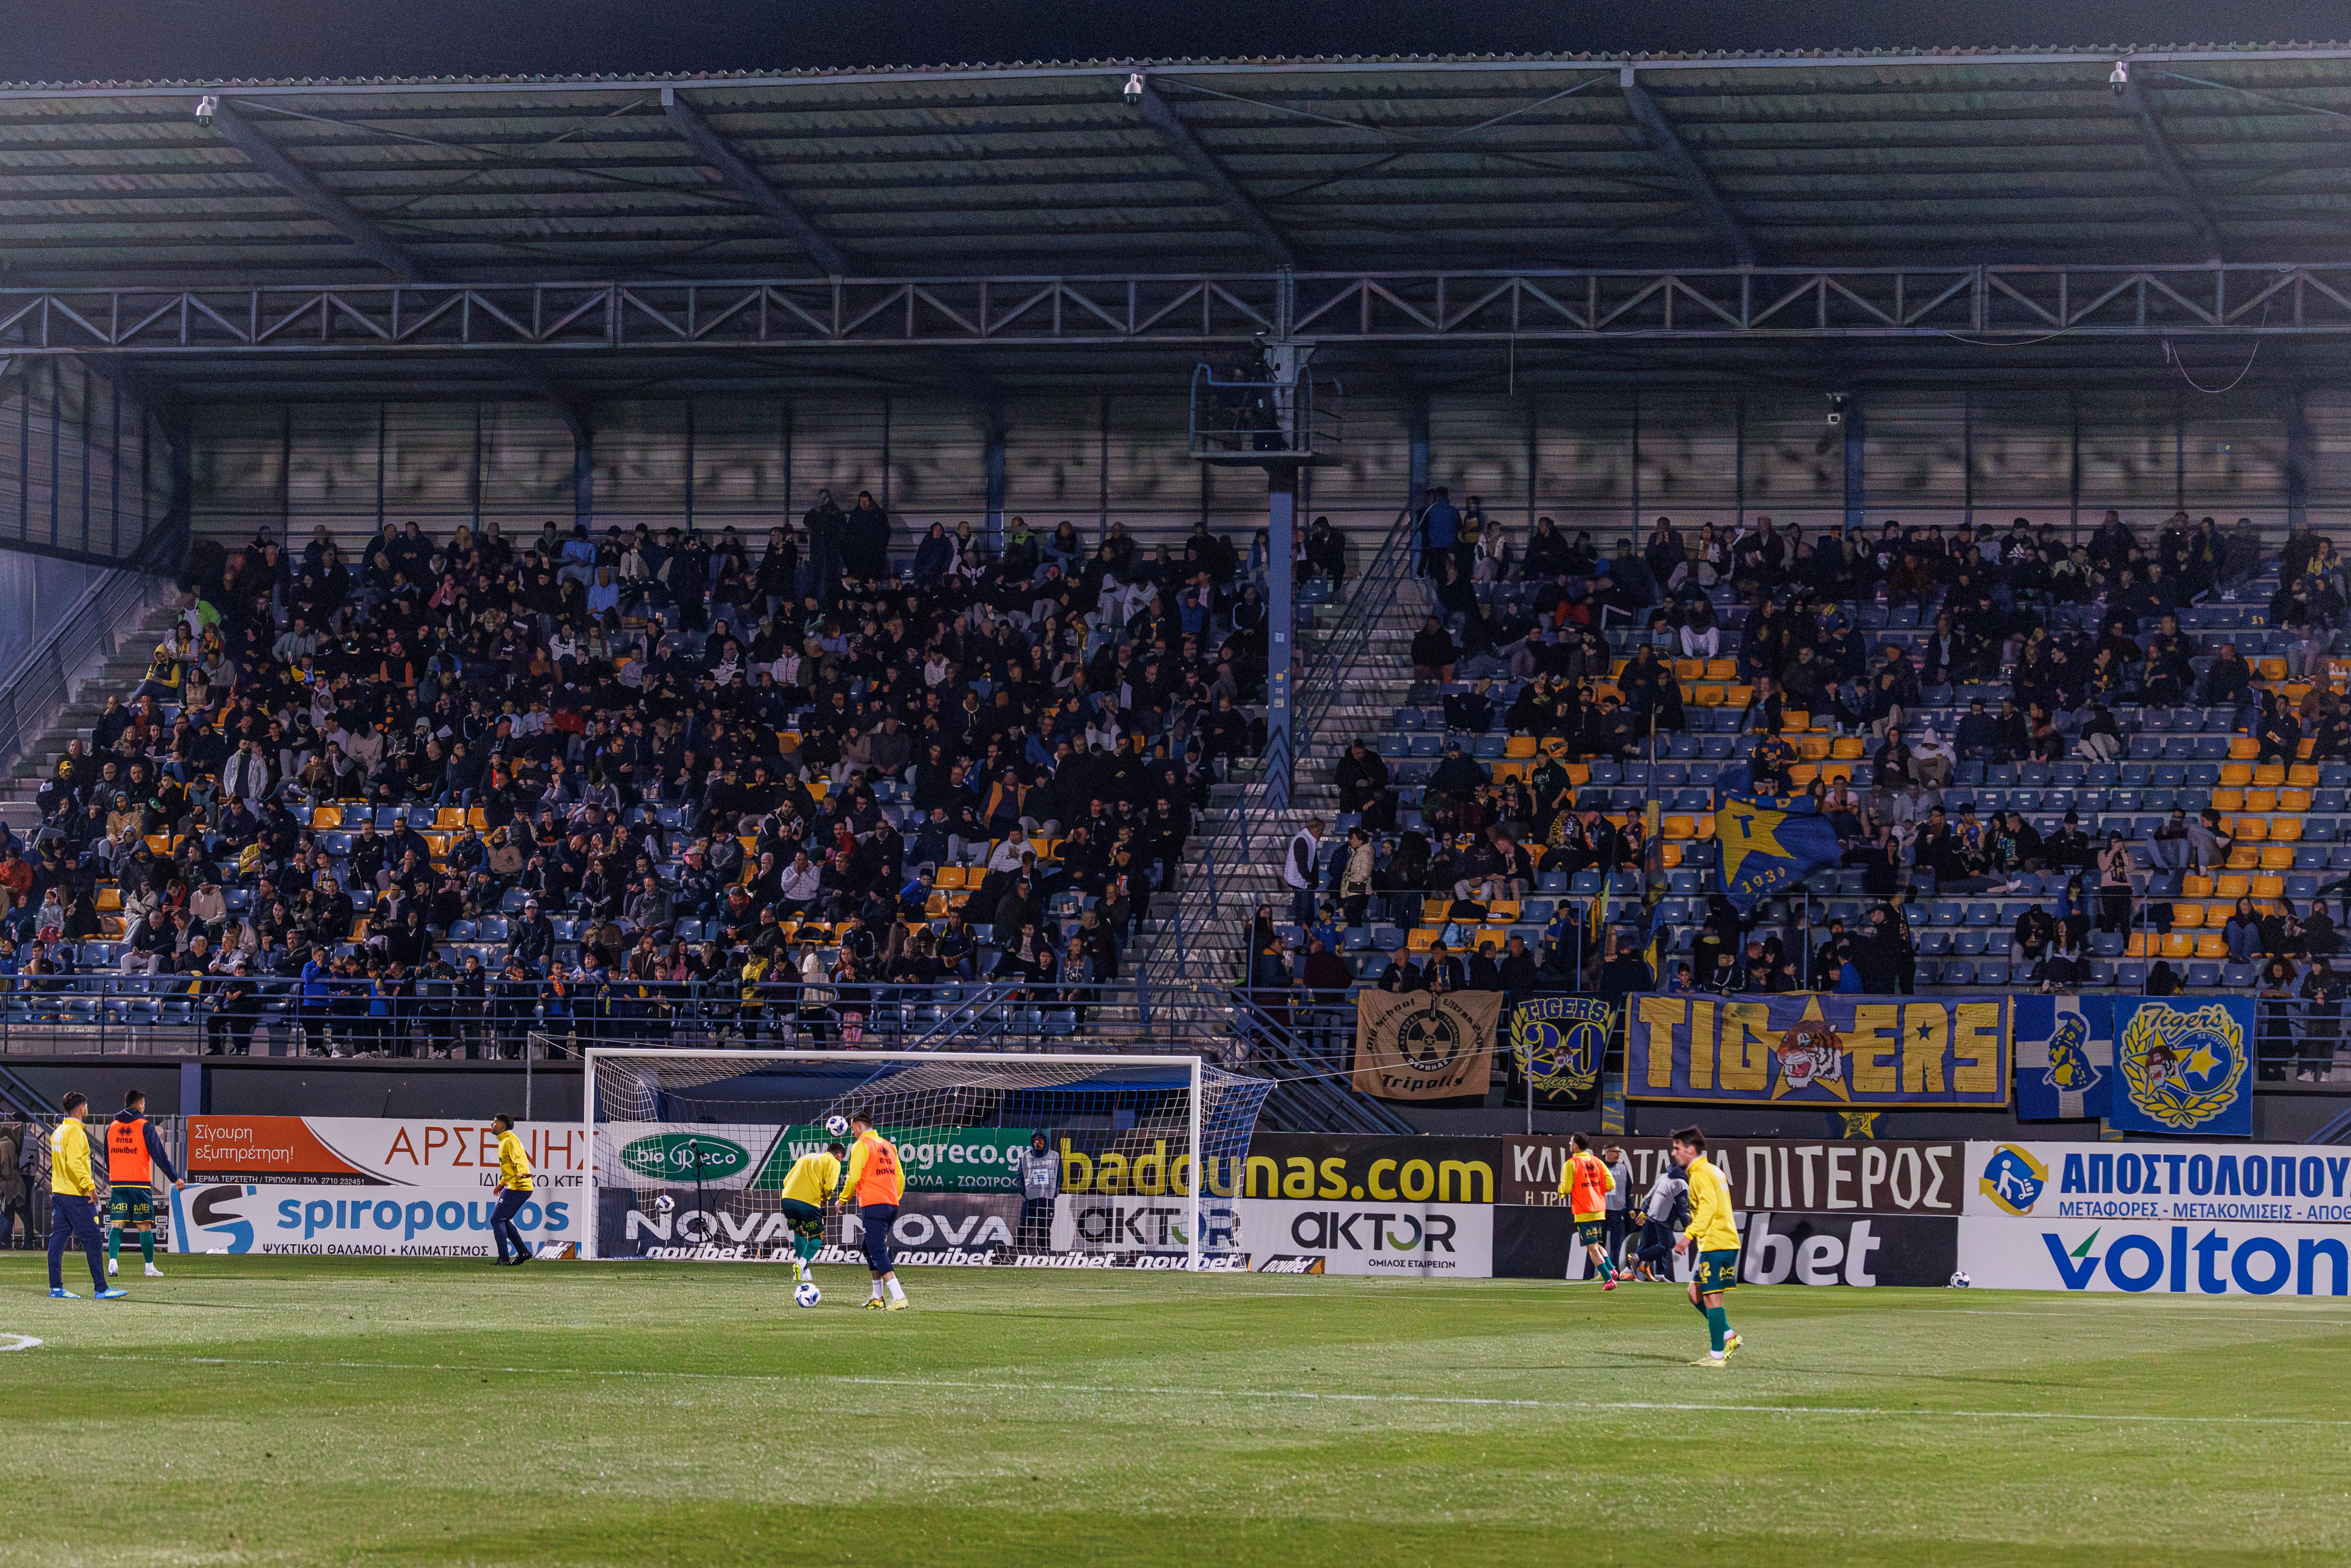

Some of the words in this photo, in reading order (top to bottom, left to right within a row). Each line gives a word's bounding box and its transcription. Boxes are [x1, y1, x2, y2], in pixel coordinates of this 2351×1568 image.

[1518, 997, 1610, 1023] TIGERS
[2141, 1004, 2223, 1036] Tigers
[1522, 1021, 1606, 1077] 20
[1382, 1074, 1464, 1091] Tripolis
[1542, 1077, 1583, 1091] years
[195, 1124, 253, 1142] Σίγουρη
[195, 1145, 294, 1163] εξυπηρέτηση!
[637, 1146, 665, 1162] bio
[1060, 1138, 1493, 1203] badounas.com
[1745, 1146, 1953, 1209] ΠΙΤΕΡΟΣ
[2060, 1152, 2351, 1198] ΑΠΟΣΤΟΛΟΠΟΥ
[112, 1203, 128, 1211] A4B
[134, 1202, 150, 1211] A4B
[2059, 1201, 2158, 1217] ΜΕΤΑΦΟΡΕΣ
[2173, 1202, 2292, 1219] ΜΕΤΑΚΟΜΙΣΕΙΣ
[277, 1199, 569, 1241] spiropouos
[626, 1210, 795, 1242] NOVA
[263, 1244, 323, 1255] ΨΥΚΤΙΚΟΙ
[327, 1244, 386, 1255] ΘΑΛΑΜΟΙ
[400, 1246, 489, 1257] ΚΛΙΜΑΤΙΣΜΟΣ
[646, 1243, 747, 1259] novibet
[894, 1248, 997, 1266] novibet
[1015, 1251, 1116, 1268] novibet
[1135, 1253, 1239, 1268] novbet
[1369, 1259, 1406, 1268] ΟΜΙΛΟΣ
[1408, 1259, 1455, 1269] ΕΤΑΙΡΕΙΩΝ
